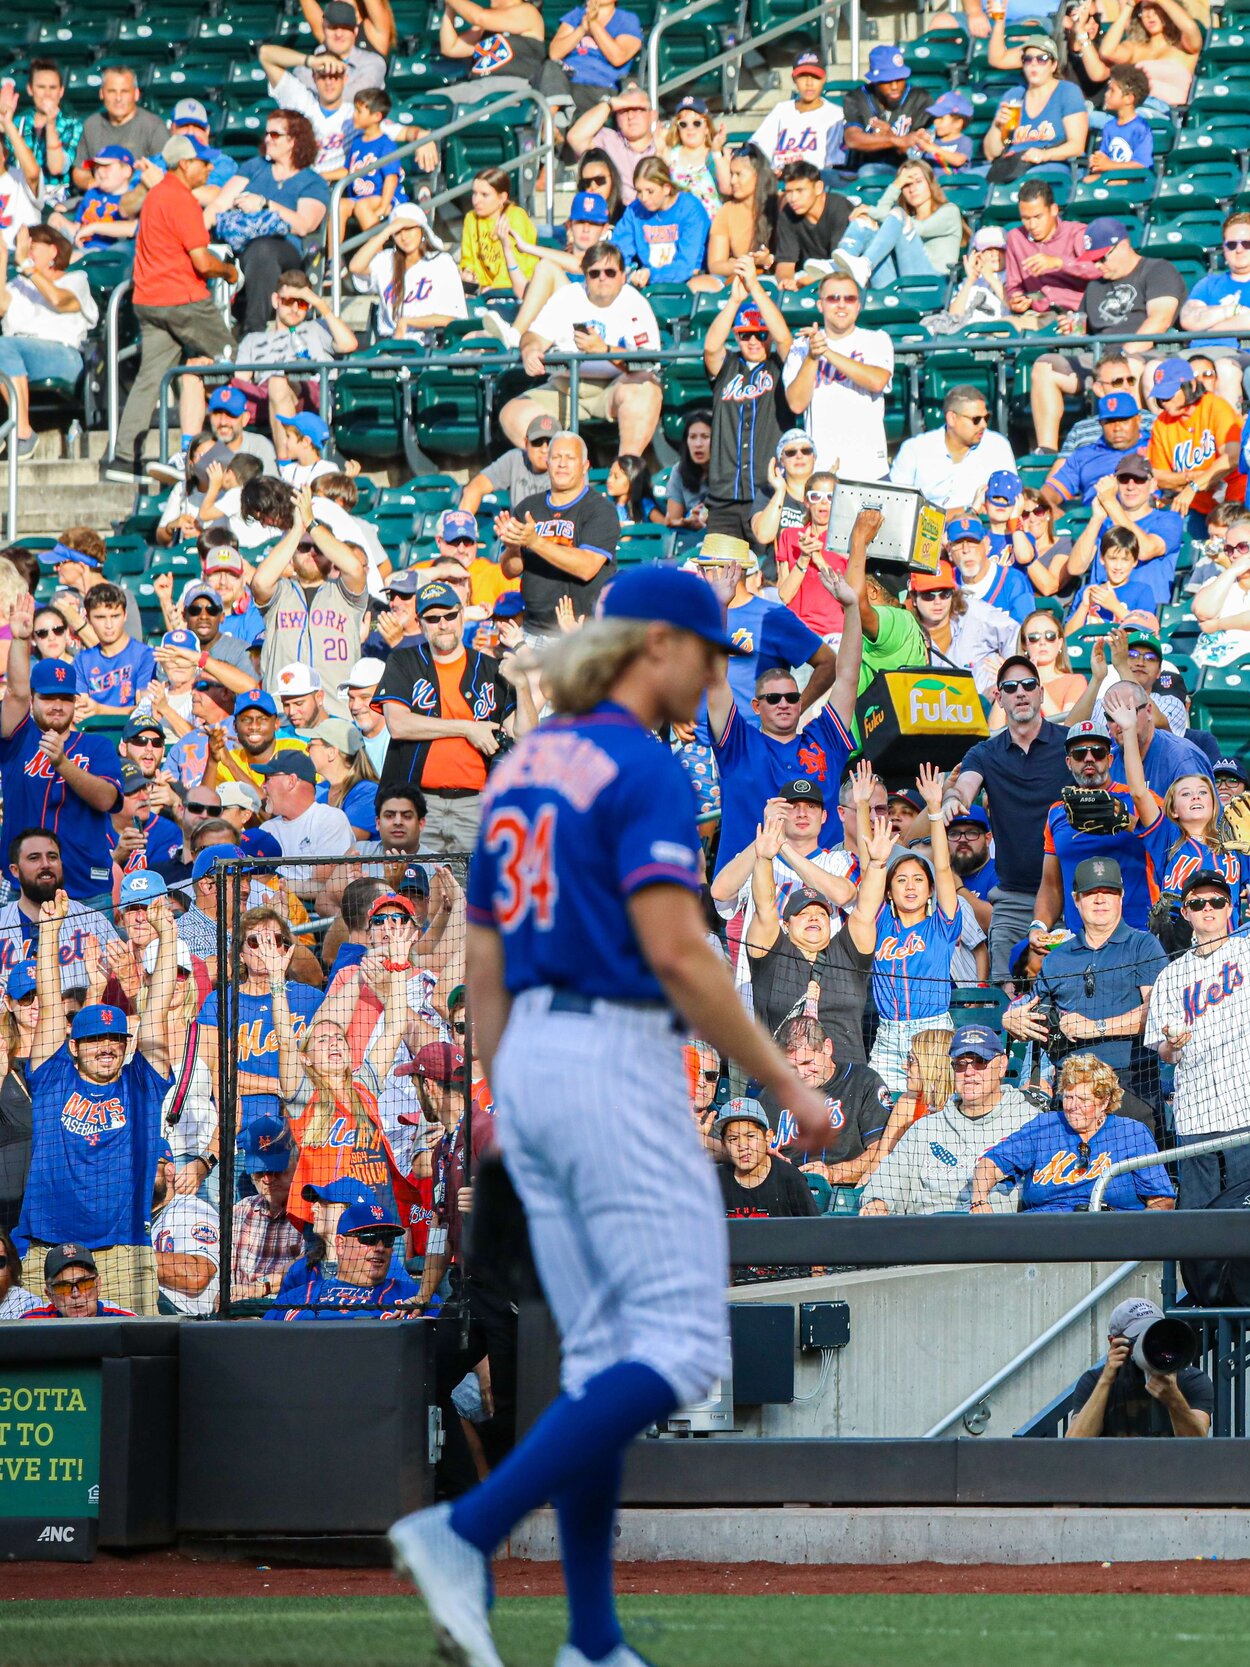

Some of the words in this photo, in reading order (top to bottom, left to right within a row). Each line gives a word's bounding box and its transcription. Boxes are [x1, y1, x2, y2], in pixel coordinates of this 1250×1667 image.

[720, 369, 775, 402] Mets
[1173, 432, 1217, 474] Mets
[322, 638, 349, 664] 20
[486, 807, 557, 928] 34
[874, 934, 927, 962] Mets
[1182, 960, 1244, 1026] Mets
[63, 1091, 123, 1124] METS
[0, 1387, 87, 1412] GOTTA
[16, 1423, 54, 1447] TO
[49, 1457, 84, 1482] IT!
[36, 1526, 76, 1543] ANC
